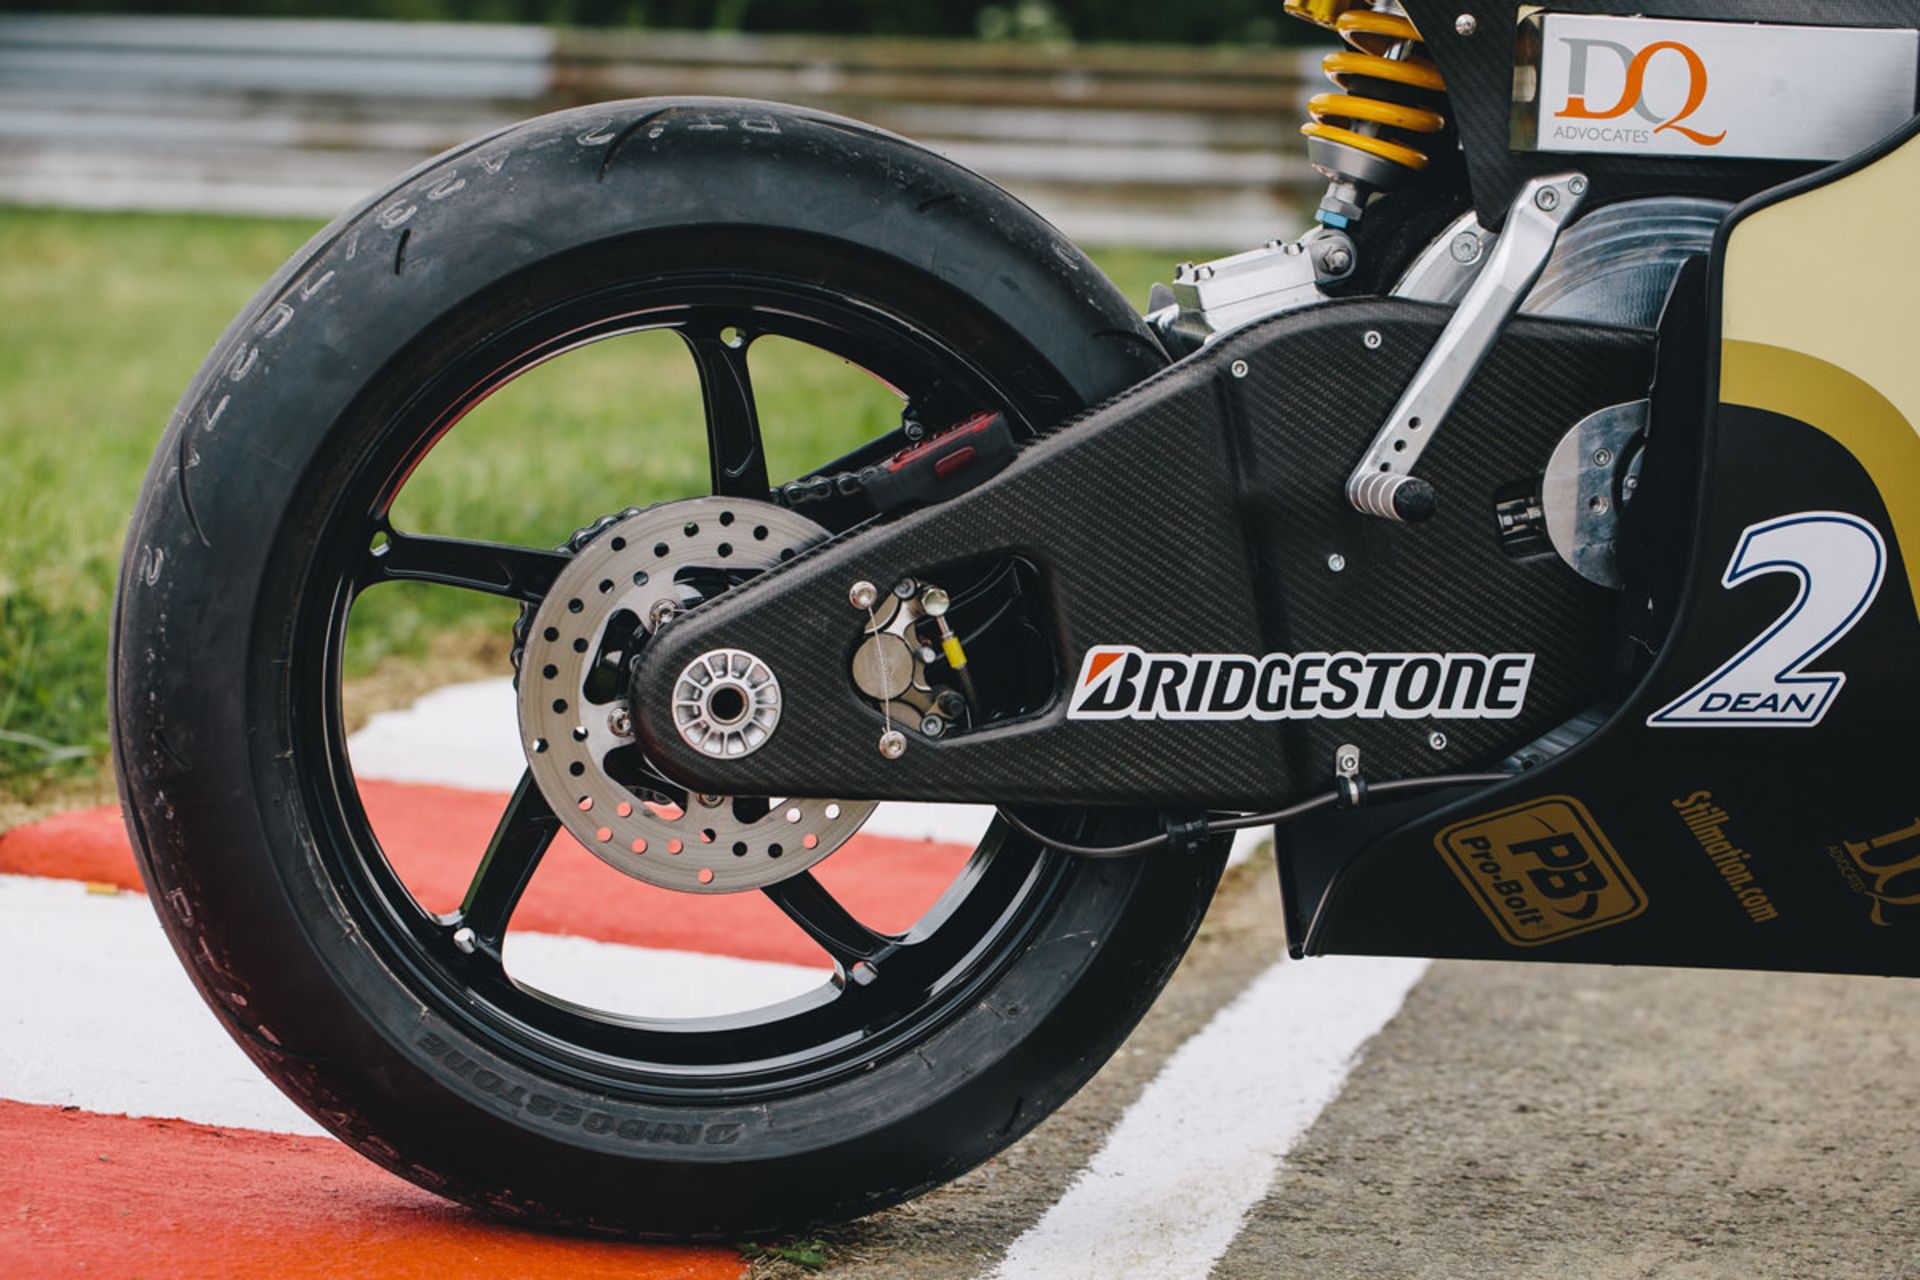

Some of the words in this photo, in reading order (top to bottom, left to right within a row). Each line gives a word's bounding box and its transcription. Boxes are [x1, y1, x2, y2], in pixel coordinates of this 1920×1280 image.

[1552, 127, 1650, 144] ADVOCATES
[1553, 38, 1727, 146] DQ
[1646, 511, 1887, 727] 2
[1073, 648, 1530, 715] BRIDGESTONE
[1699, 693, 1816, 713] DEAN
[1460, 834, 1545, 927] Pro-Bolt
[1507, 832, 1609, 902] PB
[1672, 790, 1779, 923] Stillmation.com
[415, 1032, 745, 1146] BRIDGESTONE
